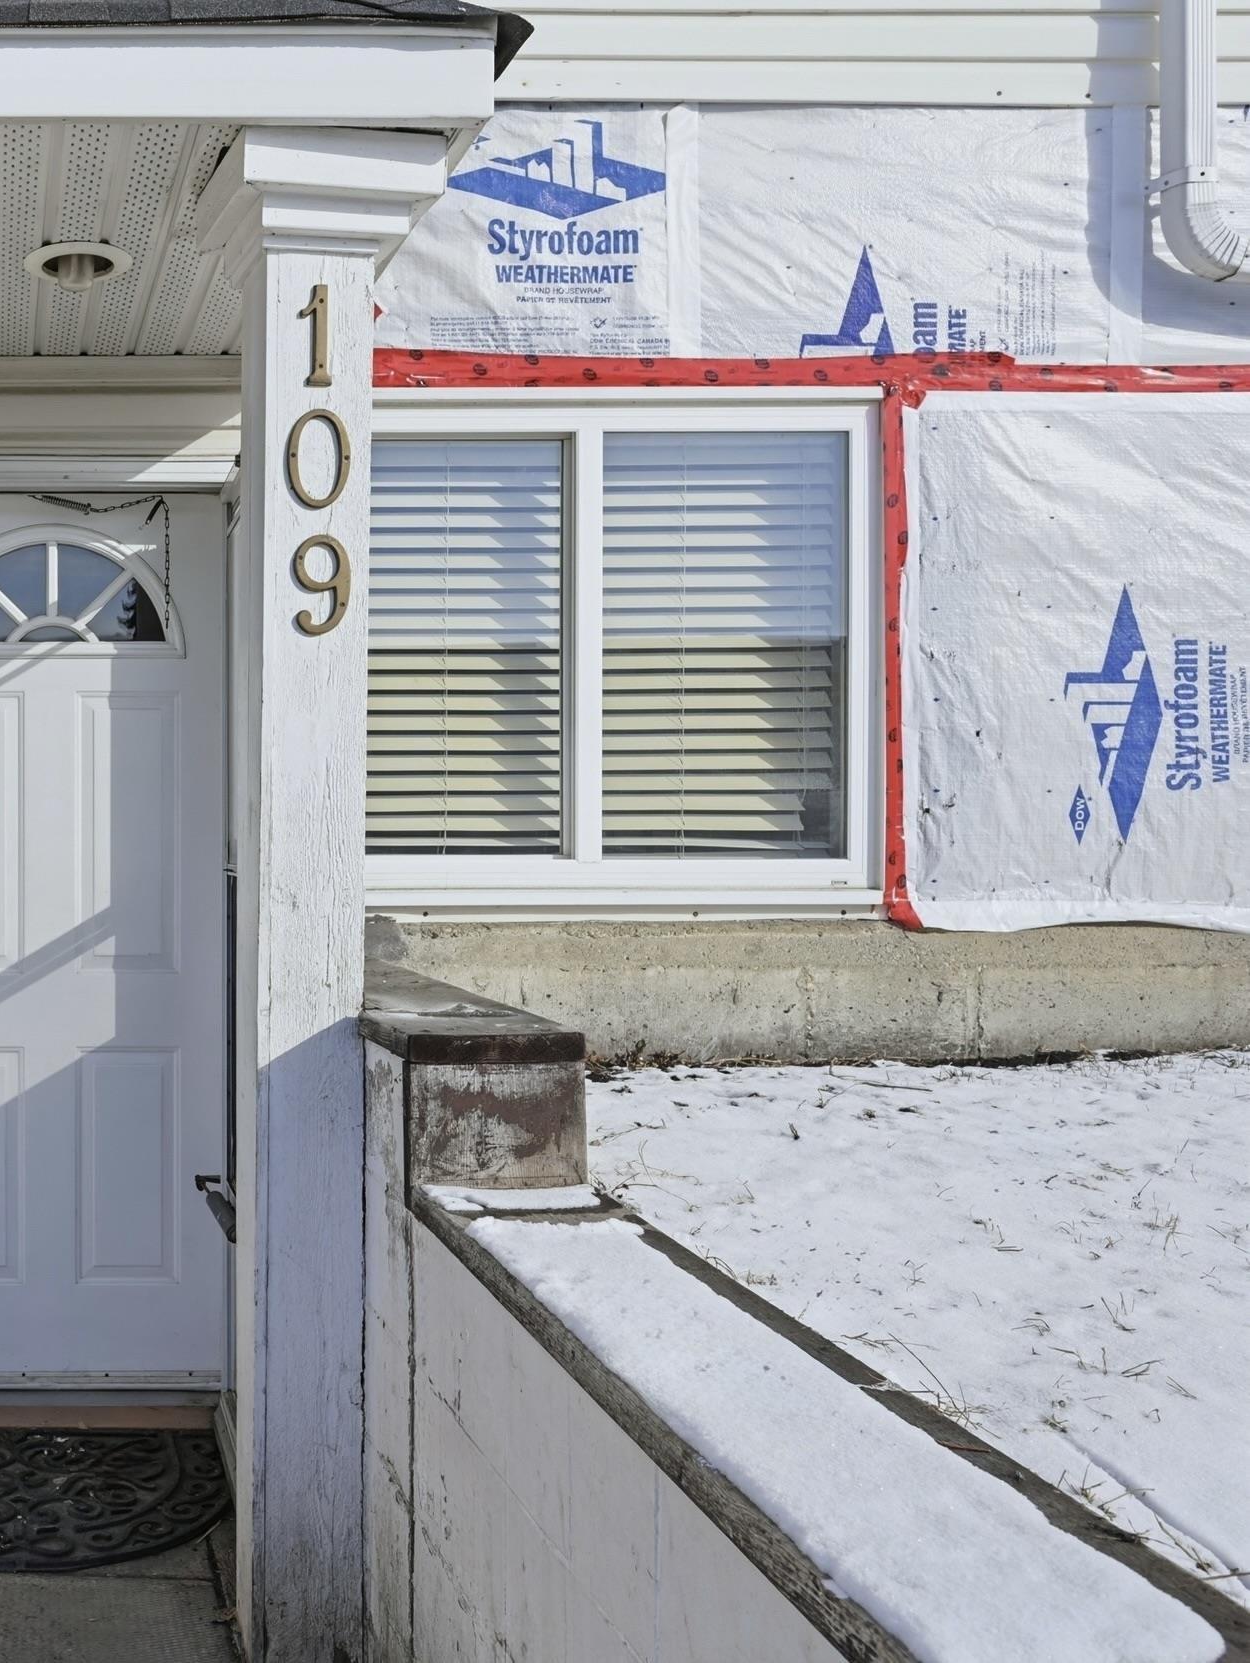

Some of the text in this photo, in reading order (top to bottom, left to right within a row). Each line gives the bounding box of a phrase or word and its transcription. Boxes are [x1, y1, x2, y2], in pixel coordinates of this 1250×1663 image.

[487, 218, 639, 261] Styrofoam
[495, 264, 635, 284] WEATHERMATE
[286, 284, 351, 636] 109
[1165, 638, 1207, 791] Styrofoam
[1209, 643, 1230, 783] WEATHERMATE
[1074, 797, 1084, 831] DOW
